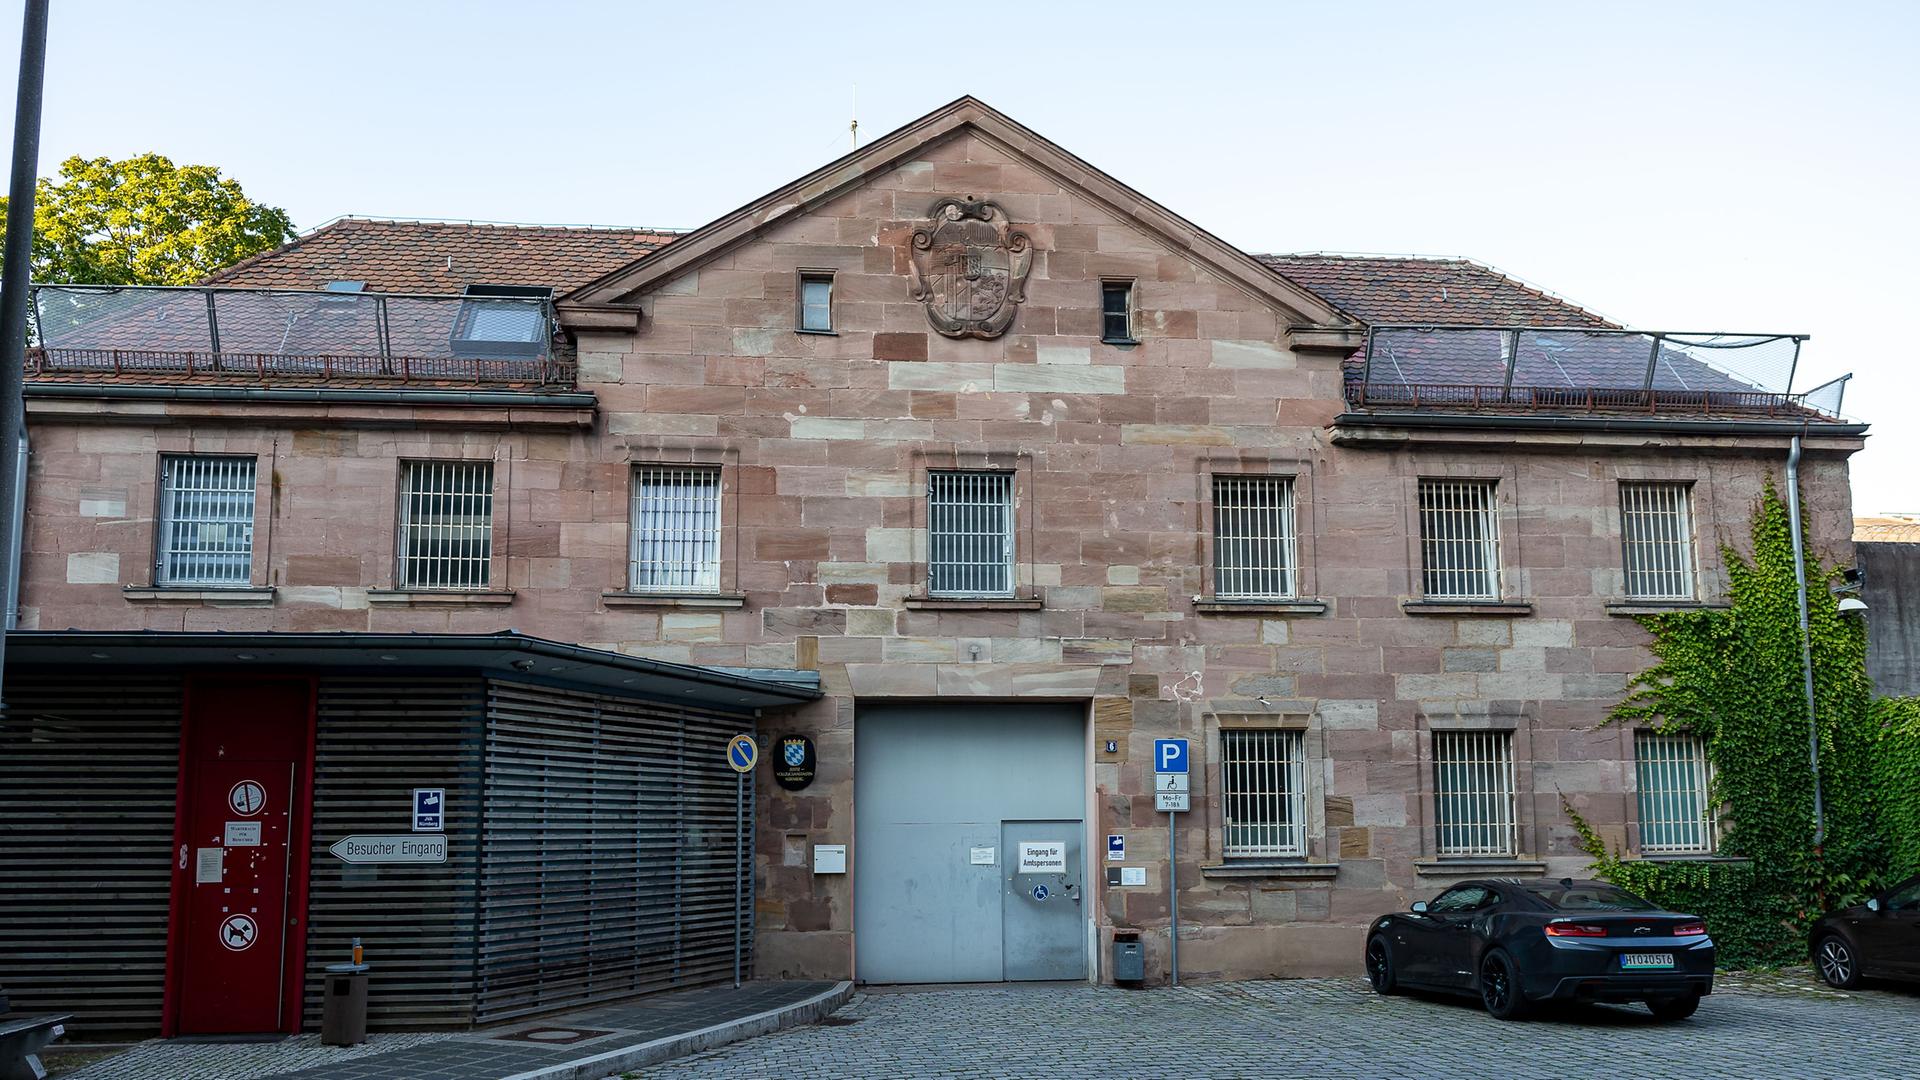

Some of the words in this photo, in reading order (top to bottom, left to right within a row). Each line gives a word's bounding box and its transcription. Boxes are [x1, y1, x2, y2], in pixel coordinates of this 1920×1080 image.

[1162, 743, 1180, 768] P
[347, 841, 395, 855] Besucher
[402, 841, 443, 857] Eingang
[1027, 848, 1049, 857] Eingang
[1050, 847, 1058, 856] für
[1023, 859, 1062, 868] Amtspersonen
